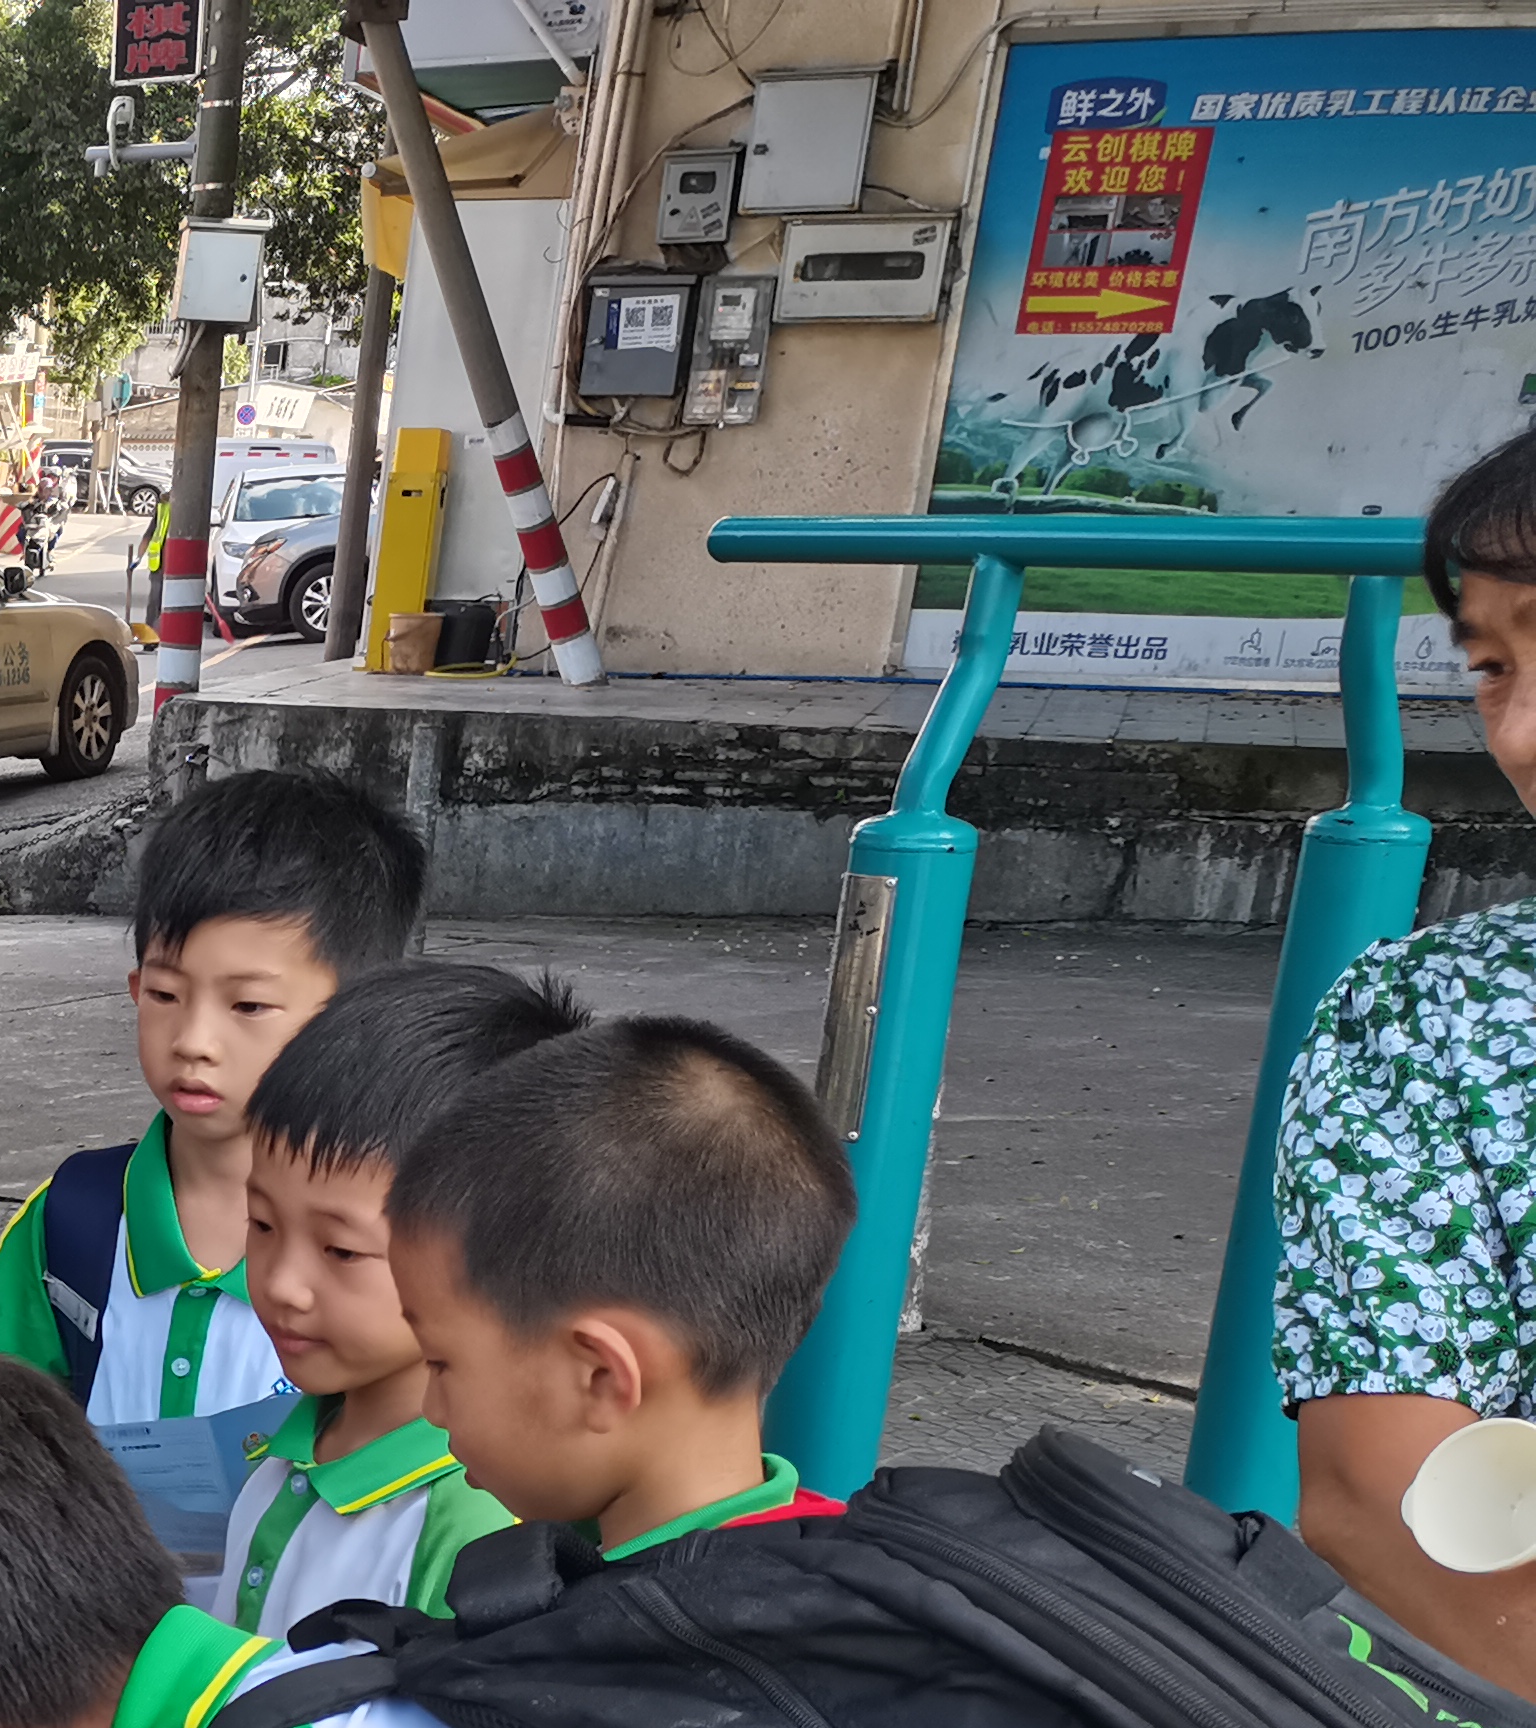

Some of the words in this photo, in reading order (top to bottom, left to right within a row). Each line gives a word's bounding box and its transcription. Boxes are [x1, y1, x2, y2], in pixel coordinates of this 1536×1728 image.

[125, 2, 190, 73] 棋牌
[1057, 87, 1155, 125] 鲜之外
[1061, 130, 1197, 164] 云创棋牌
[1030, 270, 1099, 288] 环境优美
[1109, 269, 1180, 288] 价格实惠
